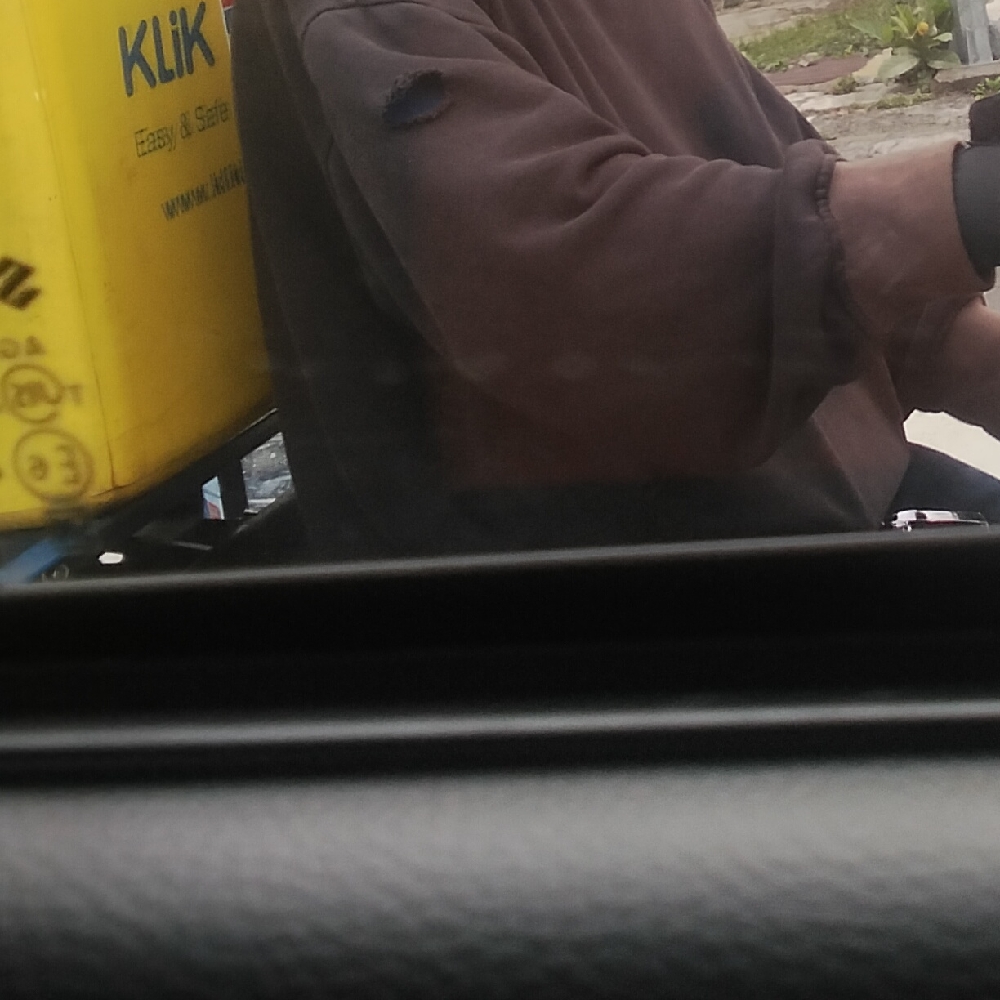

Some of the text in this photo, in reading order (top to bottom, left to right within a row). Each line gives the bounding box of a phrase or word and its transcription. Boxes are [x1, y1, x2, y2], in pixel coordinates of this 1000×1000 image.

[134, 100, 230, 158] Easy & Safe
